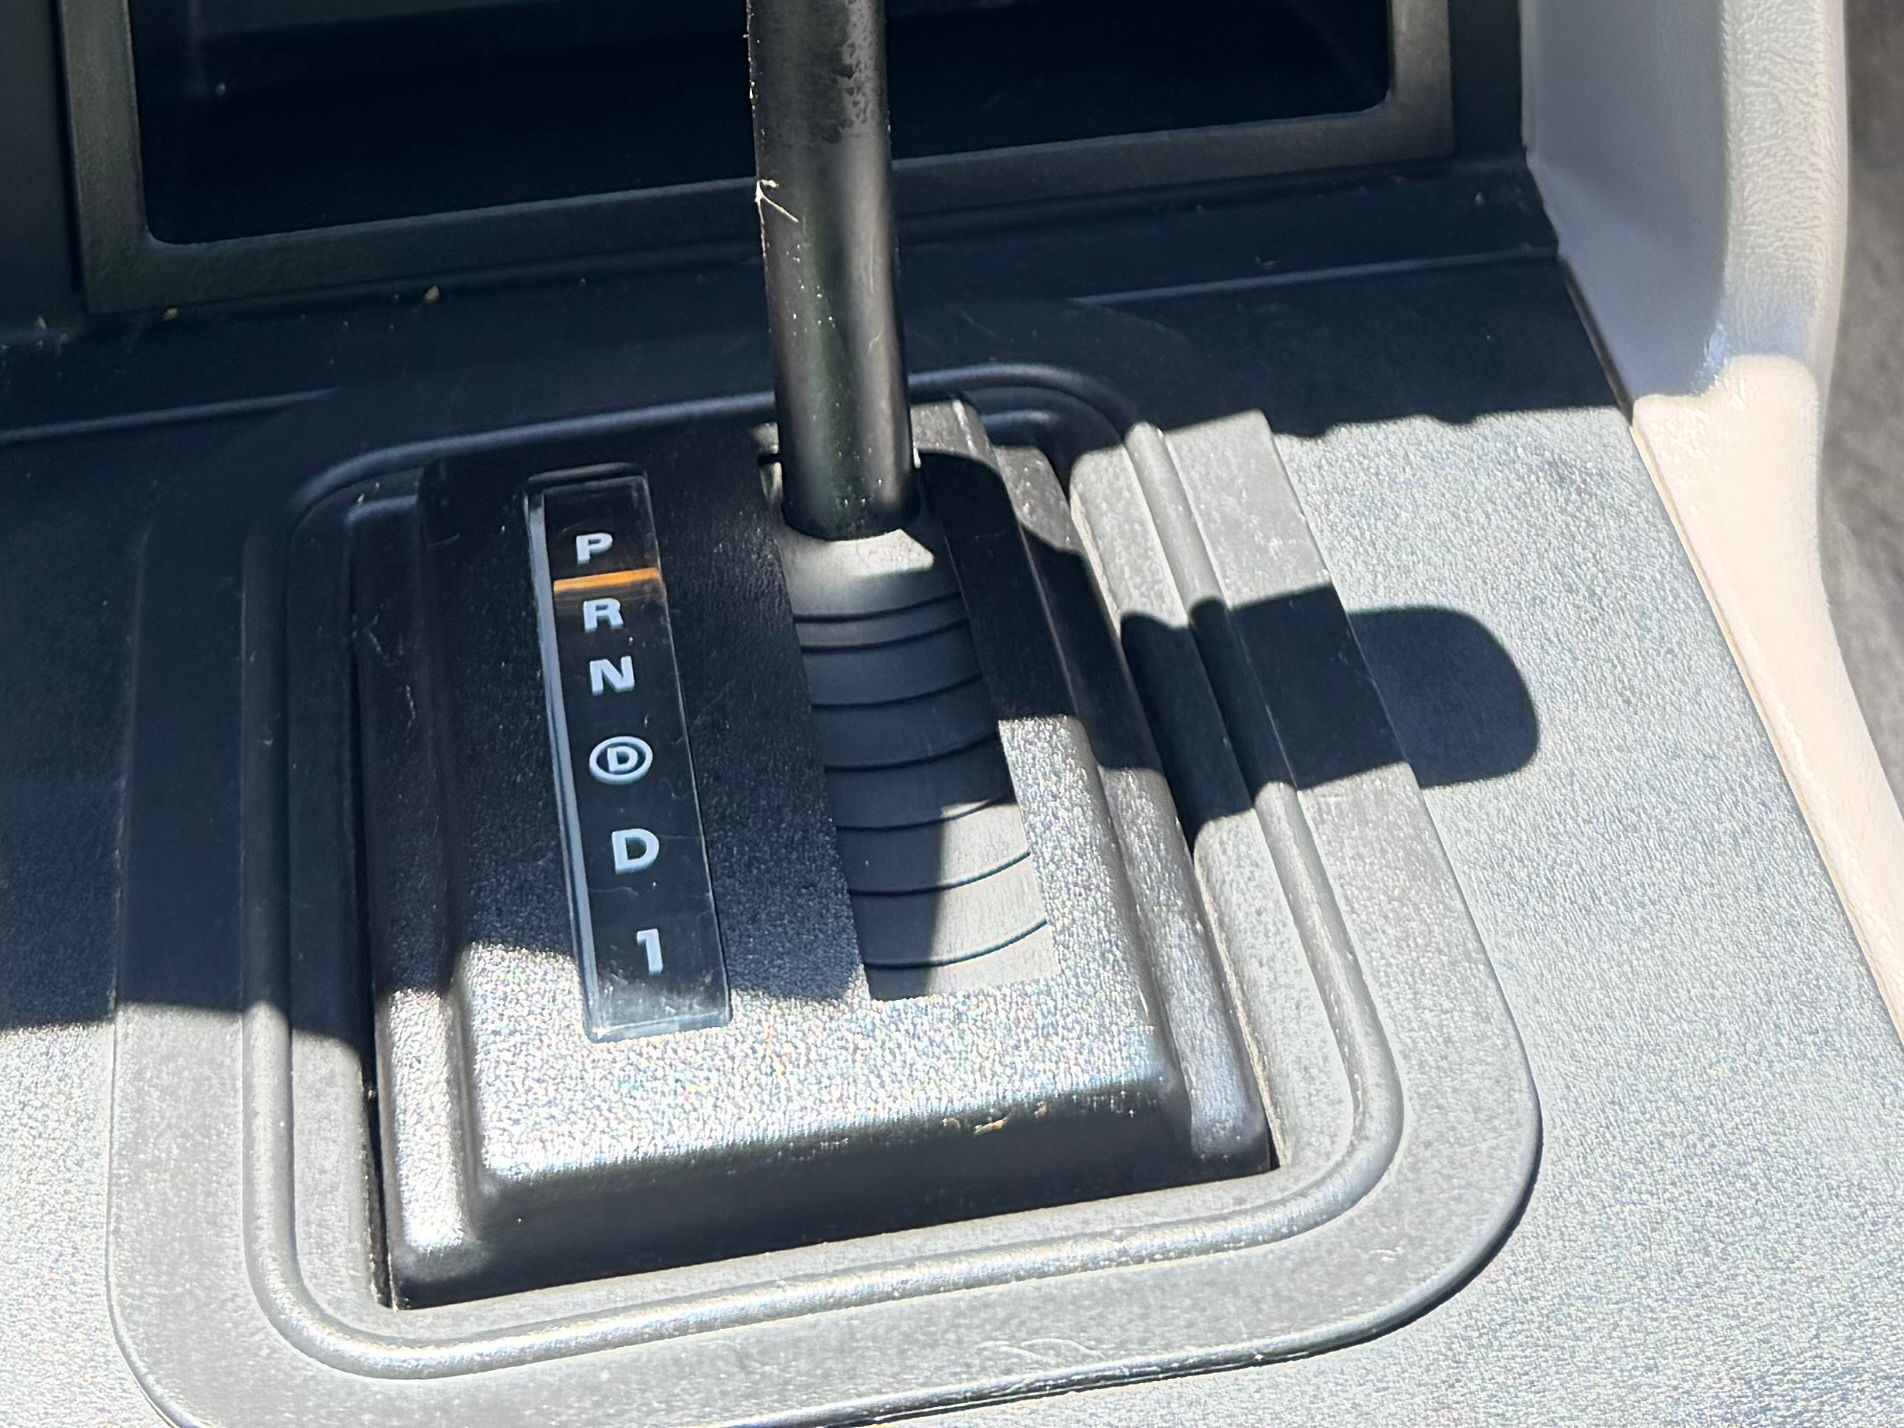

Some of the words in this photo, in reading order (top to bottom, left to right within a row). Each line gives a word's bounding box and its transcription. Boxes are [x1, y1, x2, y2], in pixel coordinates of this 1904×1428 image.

[576, 533, 612, 563] P
[583, 598, 623, 631] R
[590, 656, 634, 693] N
[612, 829, 659, 872] D
[637, 929, 663, 974] 1
